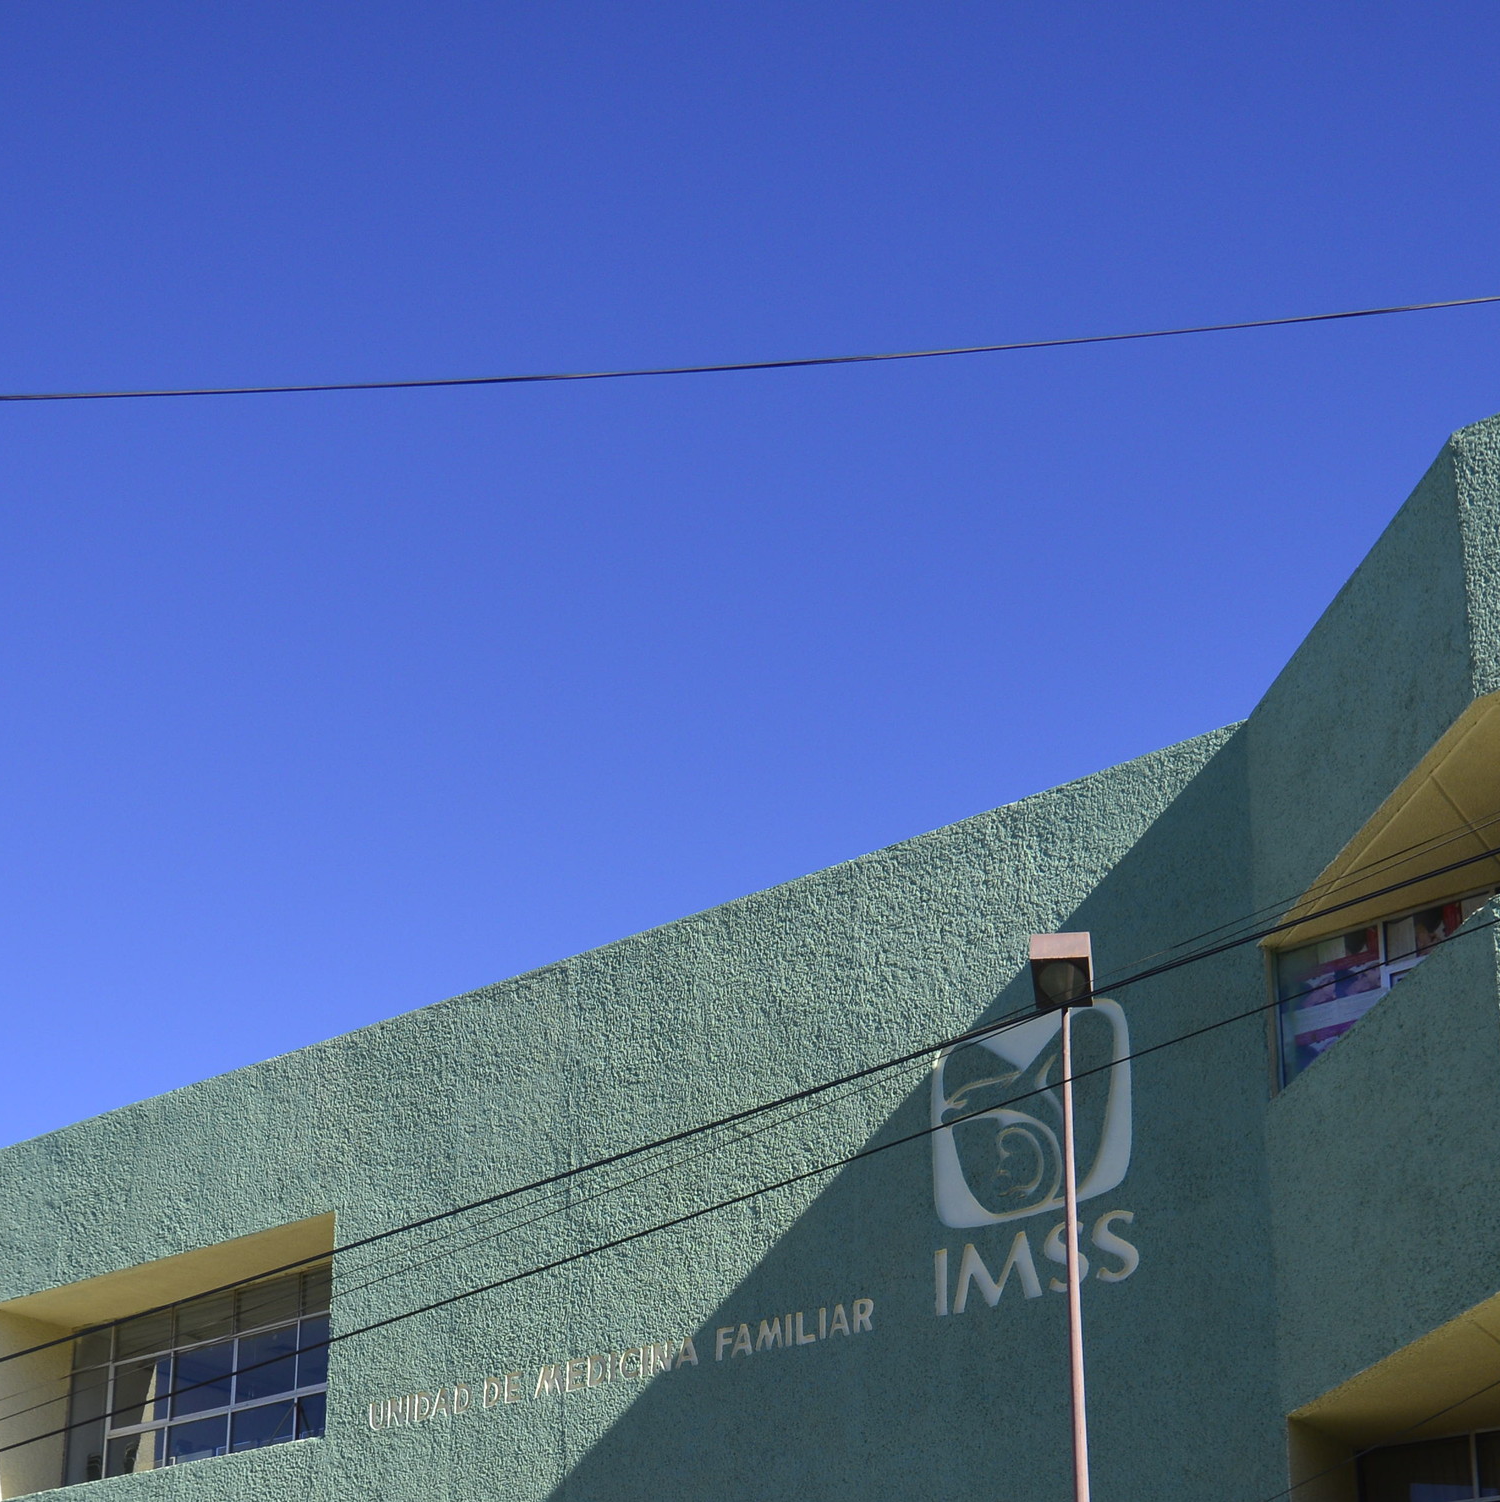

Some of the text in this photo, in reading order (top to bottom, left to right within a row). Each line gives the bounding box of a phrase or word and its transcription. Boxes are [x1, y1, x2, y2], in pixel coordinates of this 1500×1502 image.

[935, 1209, 1140, 1316] IMSS
[369, 1298, 875, 1431] UNIDAD DE MEDICINA FAMILIAR
